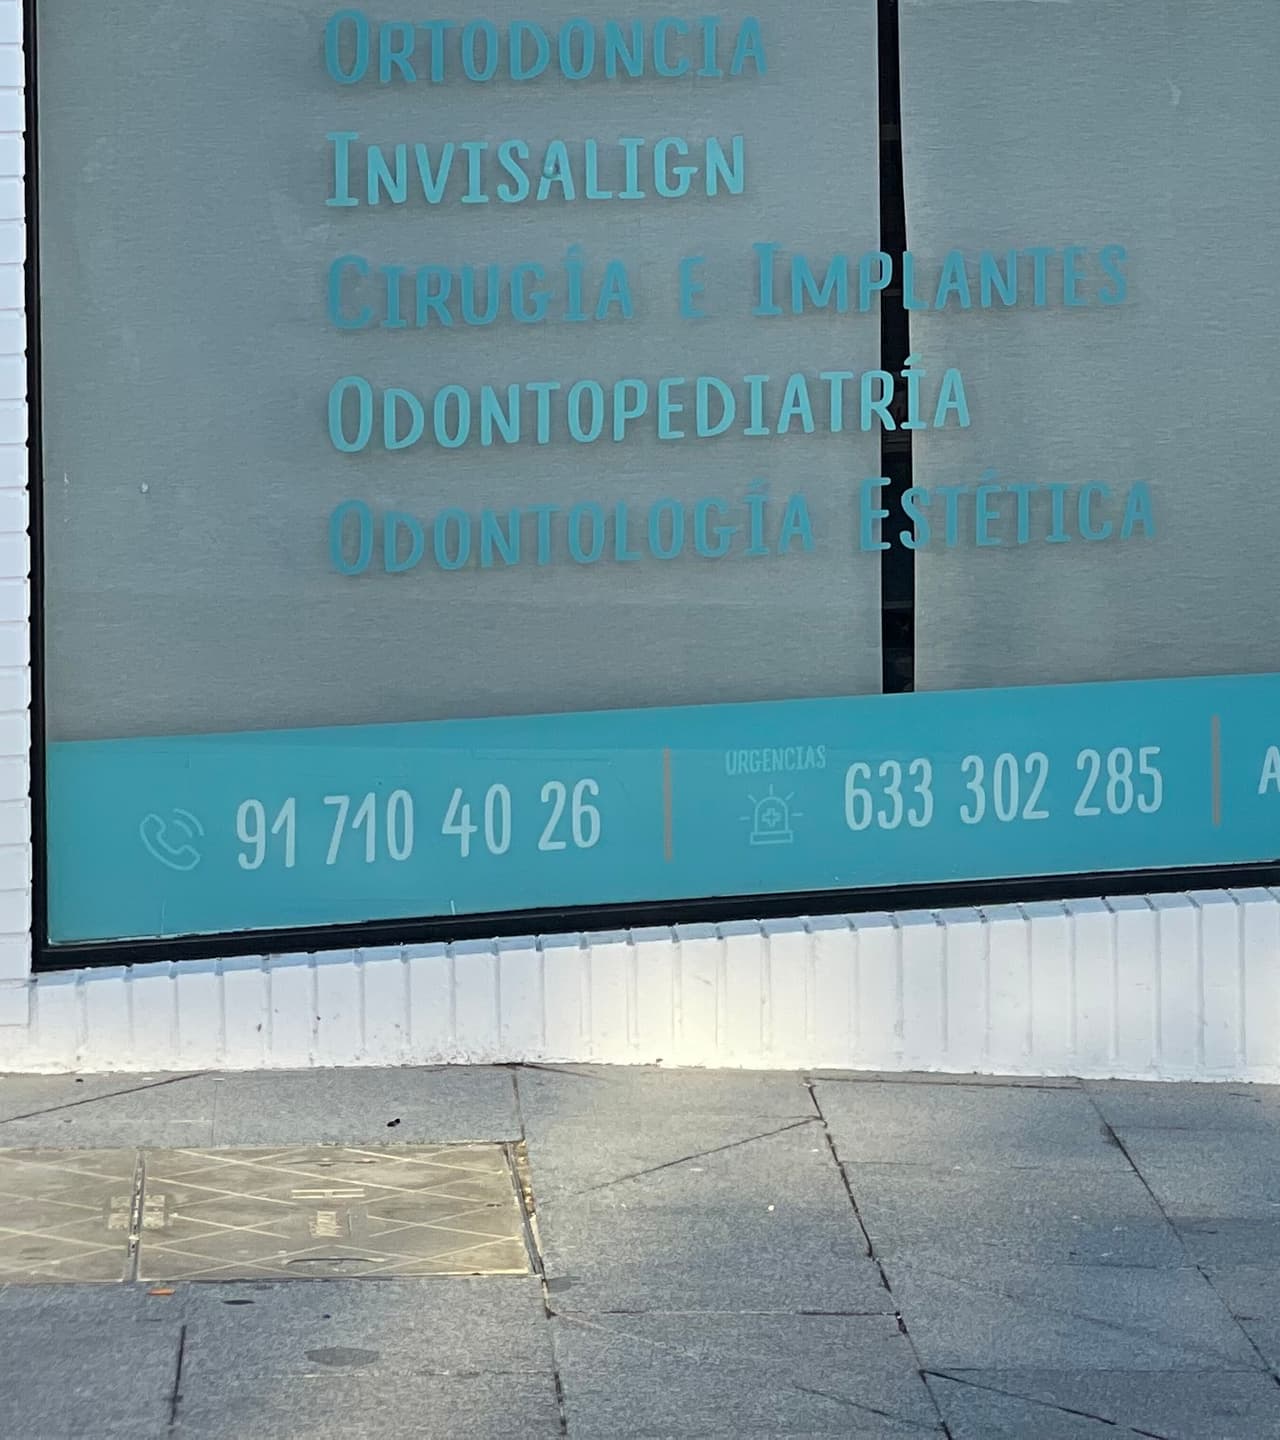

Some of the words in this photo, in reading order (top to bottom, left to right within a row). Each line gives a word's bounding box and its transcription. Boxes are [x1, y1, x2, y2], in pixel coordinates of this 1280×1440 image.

[324, 9, 769, 85] ORTODONCIA
[325, 131, 745, 208] INVISALIGN
[326, 245, 635, 331] CIRUGÍA
[678, 256, 708, 319] E
[751, 241, 1131, 317] IMPLANTES
[328, 353, 971, 453] ODONTOPEDIATRÍA
[329, 478, 815, 577] ODONTOLOGÍA
[858, 470, 1157, 553] ESTÉTICA
[725, 744, 826, 775] URGENCIAS
[843, 757, 934, 832] 633
[959, 750, 1050, 824] 302
[1074, 745, 1164, 817] 285
[235, 798, 297, 871] 91
[323, 788, 415, 866] 710
[441, 783, 512, 859] 40
[538, 777, 601, 852] 26
